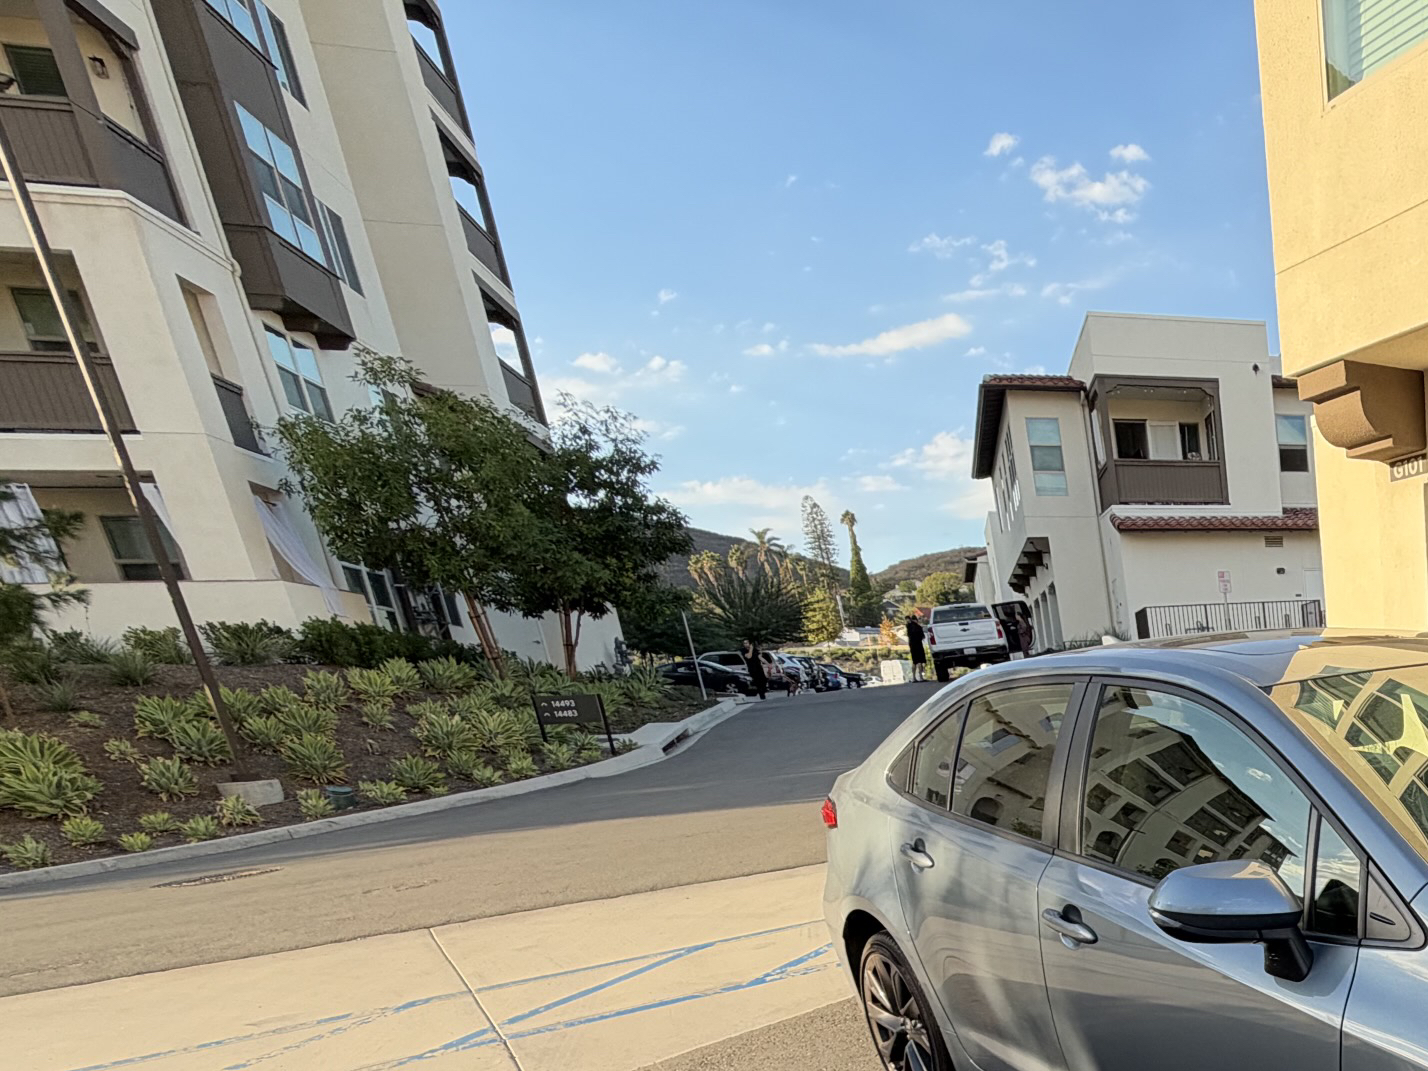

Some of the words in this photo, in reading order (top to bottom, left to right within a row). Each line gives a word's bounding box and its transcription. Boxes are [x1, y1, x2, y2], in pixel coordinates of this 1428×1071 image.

[1393, 456, 1424, 479] G101
[551, 699, 576, 708] 14493
[554, 709, 579, 718] 14483
